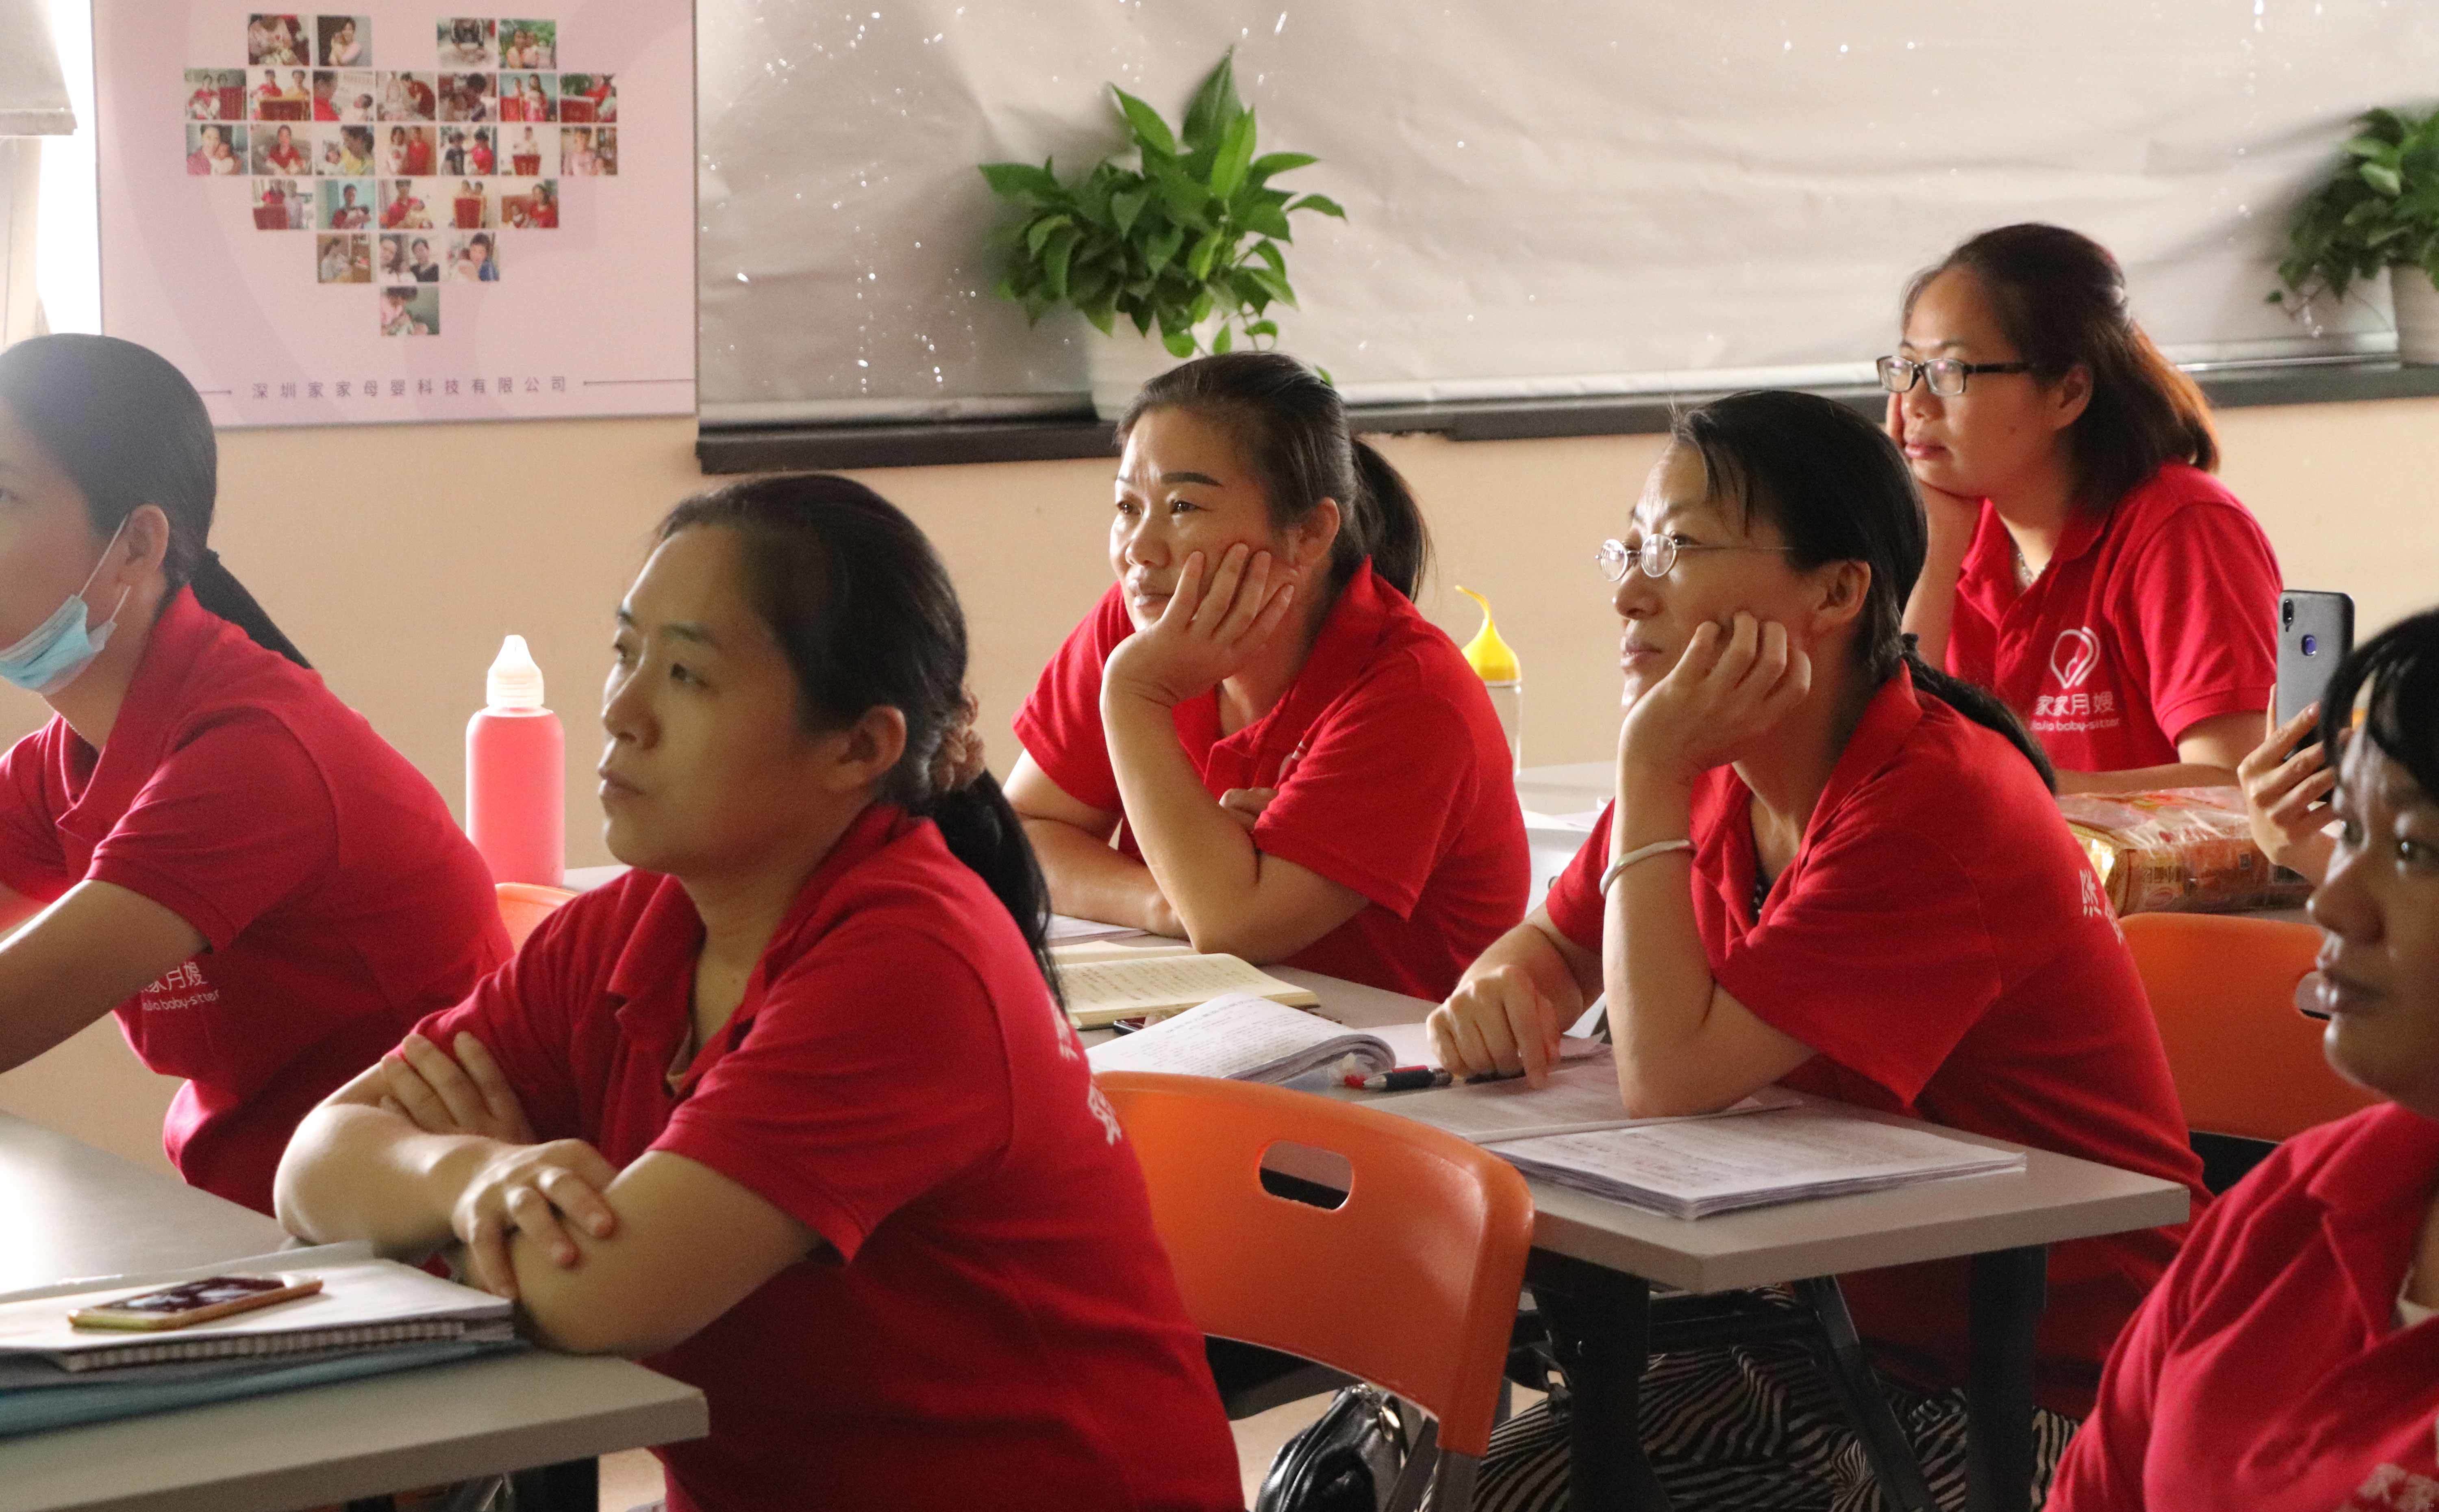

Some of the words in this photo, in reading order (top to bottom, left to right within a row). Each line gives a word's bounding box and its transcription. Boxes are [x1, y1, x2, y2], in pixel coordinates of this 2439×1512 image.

[252, 376, 565, 399] 深圳家家母婴科技有限公司
[2034, 691, 2114, 717] 家家月嫂
